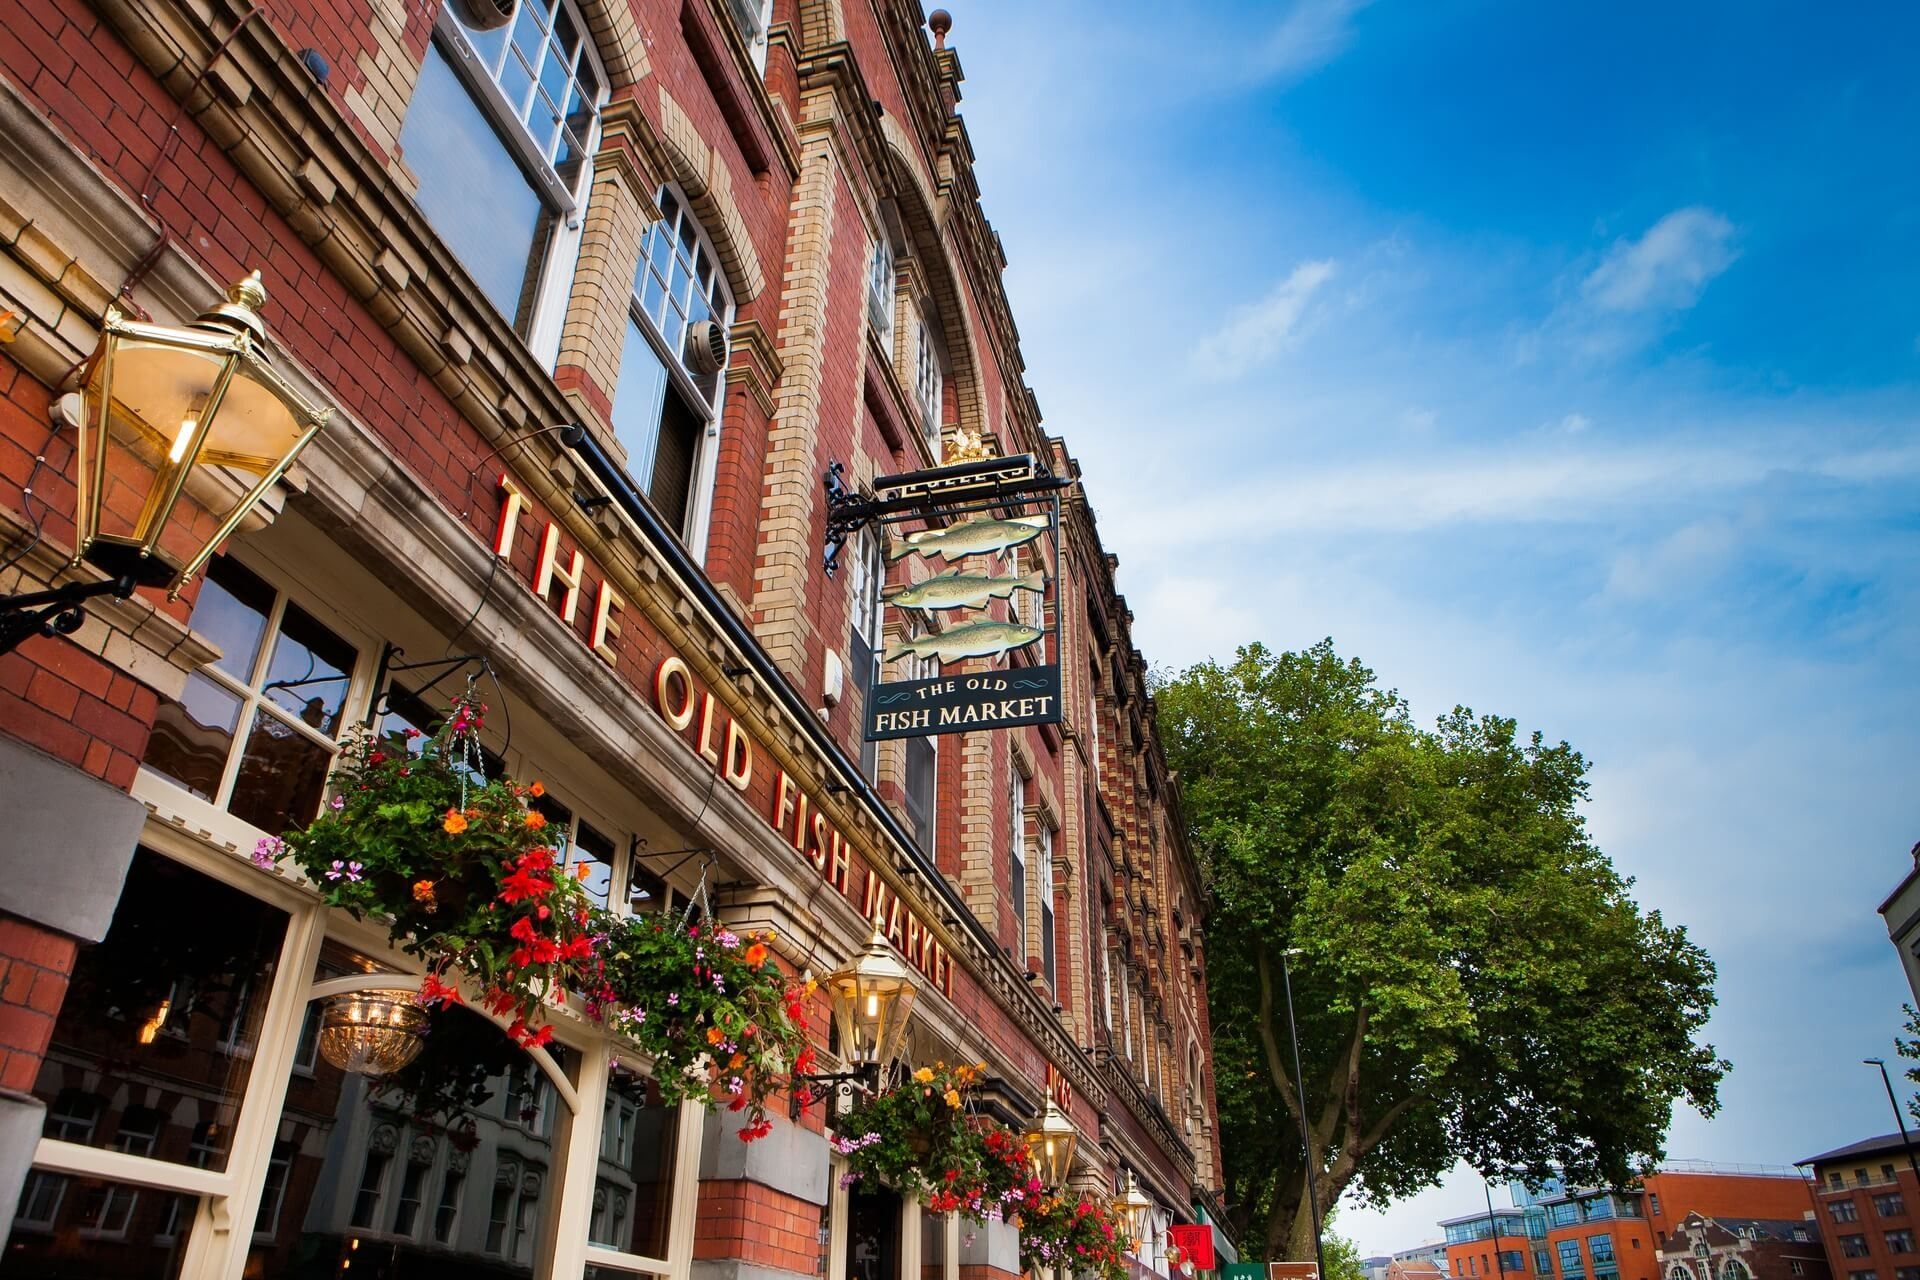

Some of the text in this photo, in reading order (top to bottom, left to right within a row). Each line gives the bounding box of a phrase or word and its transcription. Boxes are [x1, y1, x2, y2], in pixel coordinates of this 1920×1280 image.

[916, 678, 1008, 700] THE OLD
[874, 696, 1053, 733] FISH MARKET
[494, 473, 954, 1001] THE OLD FISH MARKET
